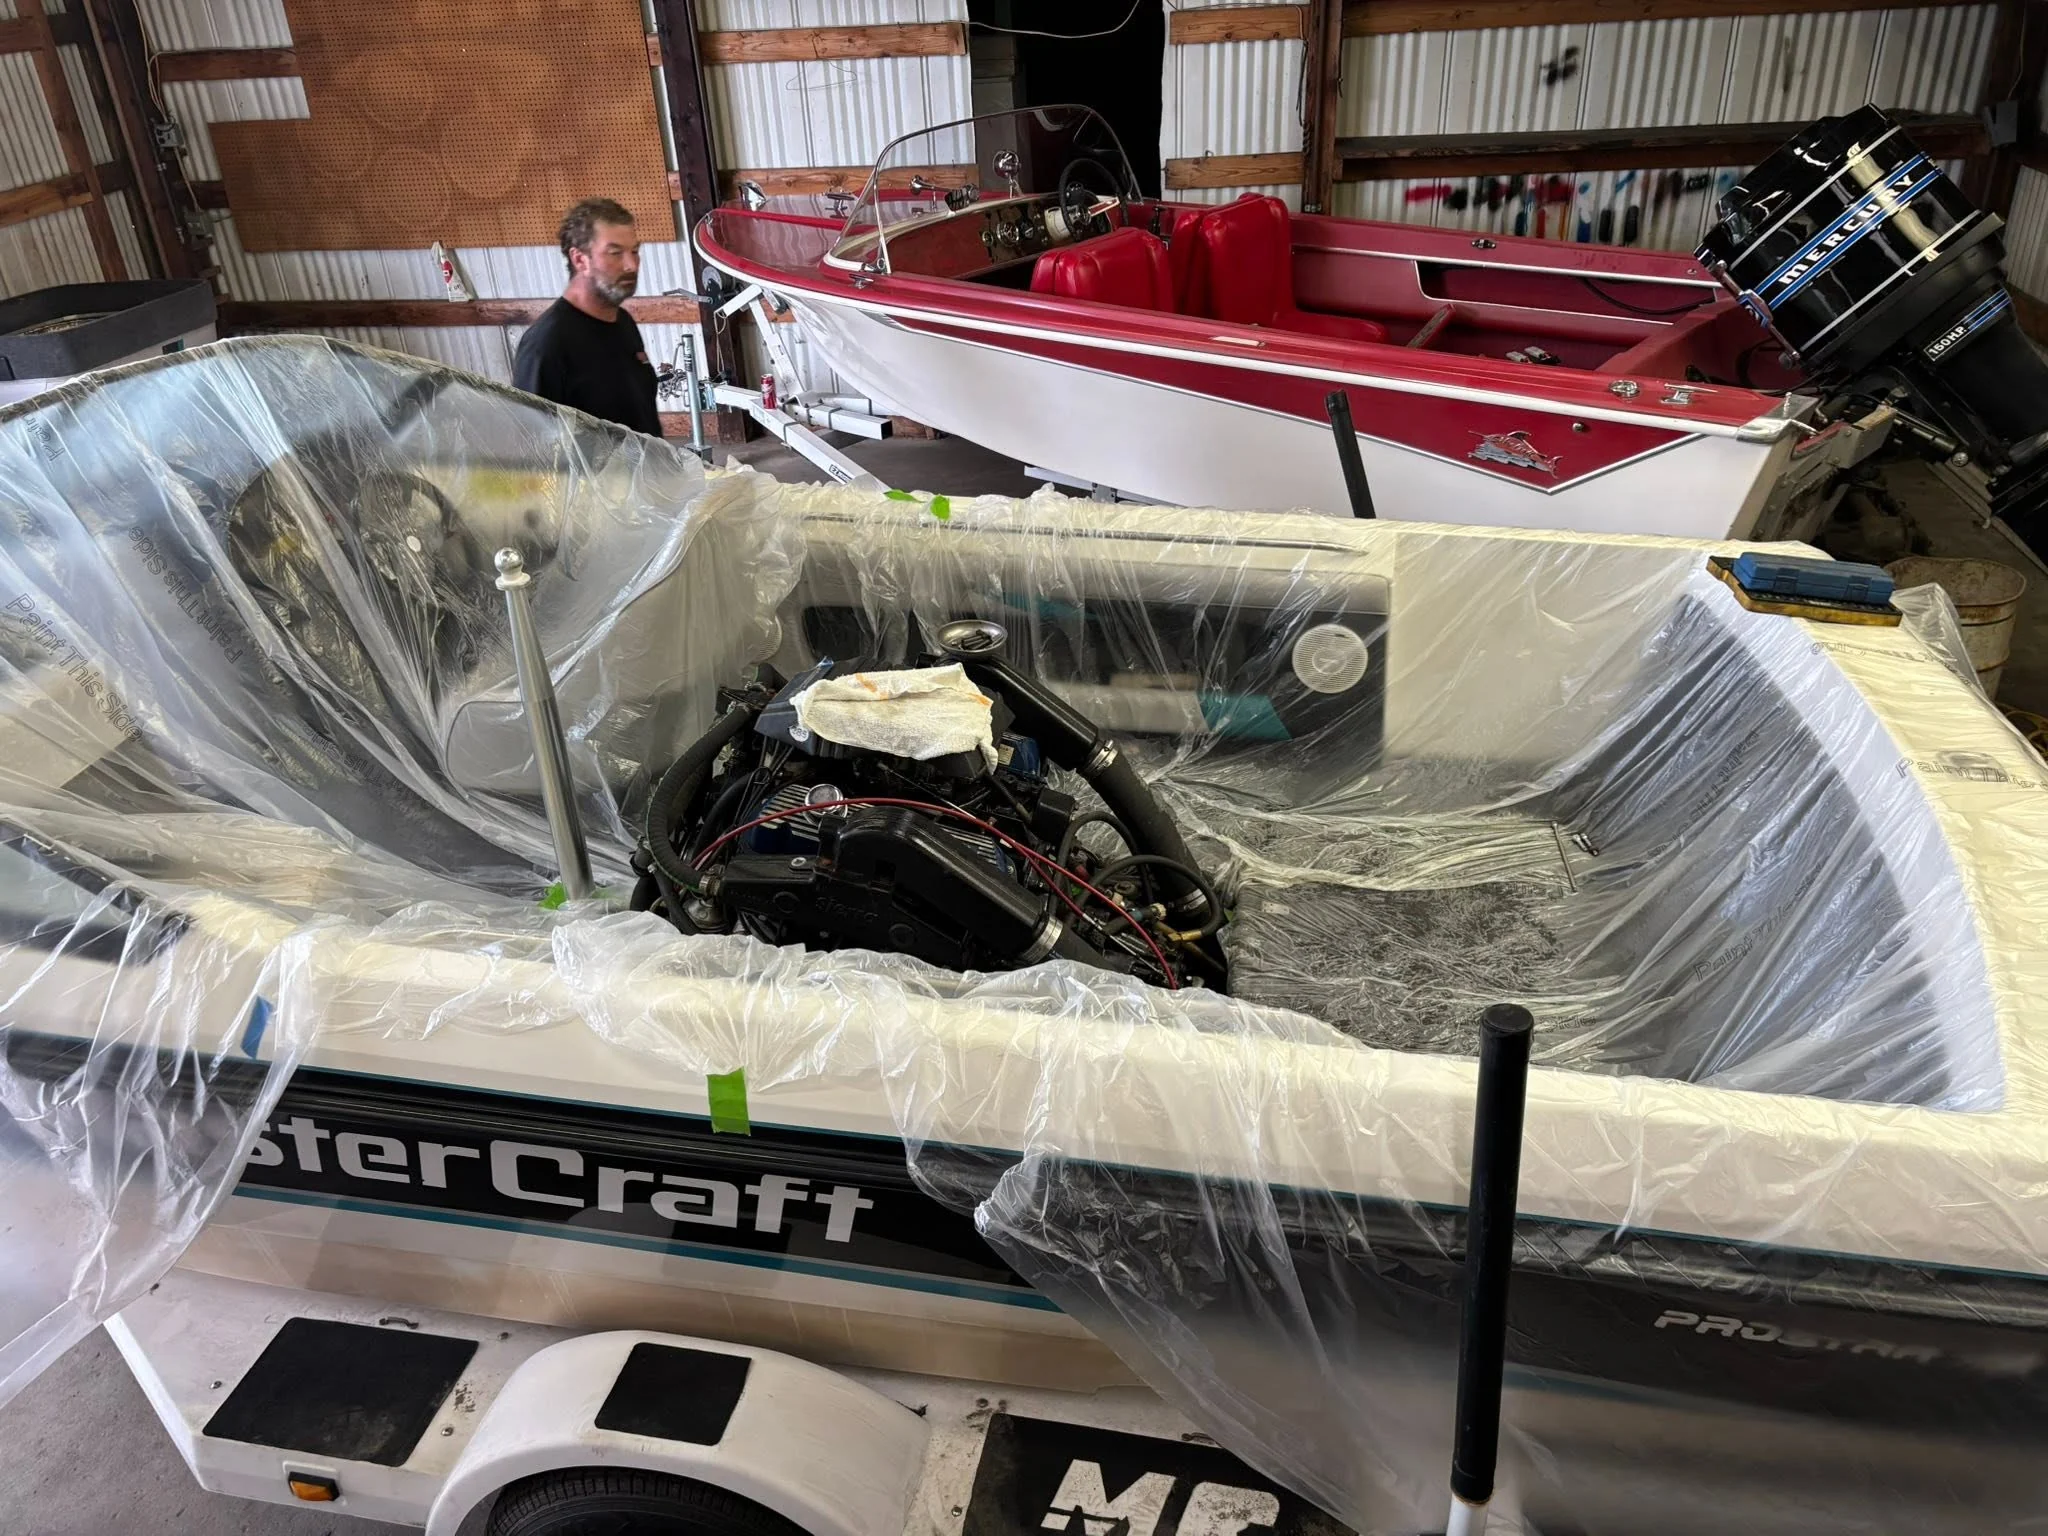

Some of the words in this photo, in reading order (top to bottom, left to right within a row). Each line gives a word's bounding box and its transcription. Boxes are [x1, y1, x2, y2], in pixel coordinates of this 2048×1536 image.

[1779, 171, 1916, 287] MERCURY
[128, 526, 168, 576] Side
[163, 569, 199, 619] This
[196, 609, 244, 664] Paint
[5, 592, 67, 656] Paint
[59, 645, 104, 698] This
[98, 691, 144, 742] Side
[240, 1113, 875, 1244] sterCraft
